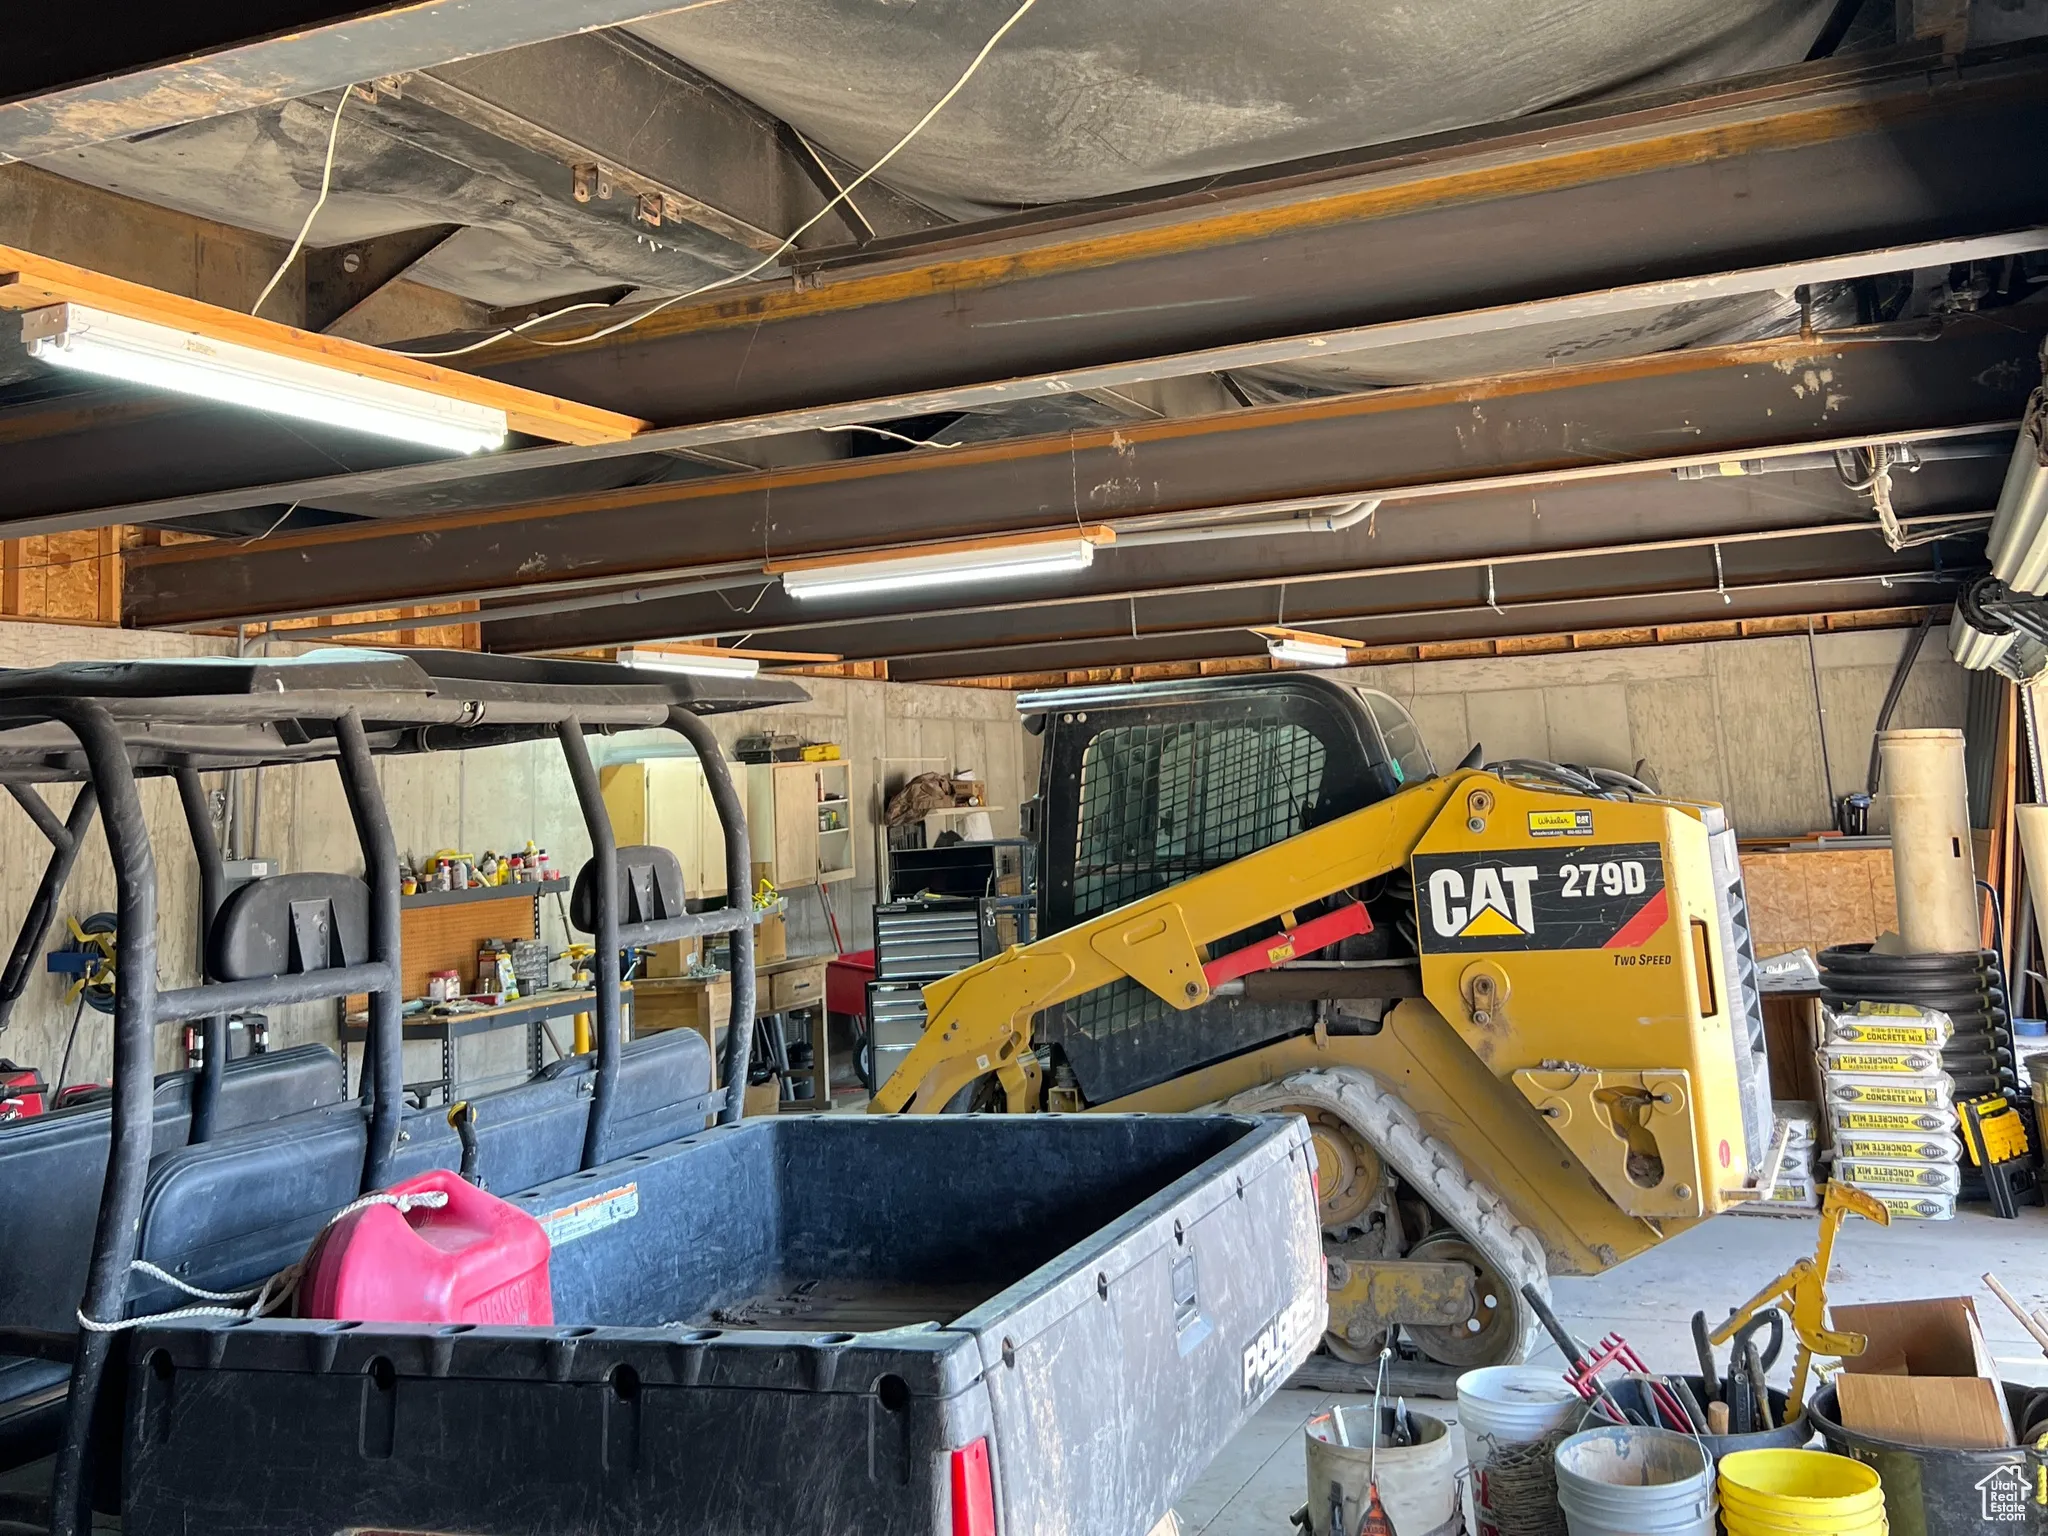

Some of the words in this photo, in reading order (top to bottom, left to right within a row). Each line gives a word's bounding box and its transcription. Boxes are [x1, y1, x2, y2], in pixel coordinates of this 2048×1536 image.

[1576, 815, 1589, 824] CAT
[1559, 861, 1646, 897] 279D
[1429, 866, 1538, 937] CAT
[1613, 954, 1636, 967] TWO
[1639, 953, 1672, 966] SPEED
[1866, 1033, 1906, 1041] CONCRETE
[1843, 1056, 1857, 1064] MIX
[1866, 1093, 1906, 1102] CONCRETE
[1908, 1095, 1923, 1103] MIX
[1852, 1114, 1866, 1122] MIX
[1869, 1115, 1909, 1123] CONCRETE
[1854, 1143, 1870, 1151] MIX
[1872, 1143, 1912, 1152] CONCRETE
[1856, 1166, 1872, 1175] MIX
[1874, 1167, 1915, 1177] CONCRETE
[1885, 1200, 1909, 1209] CONC
